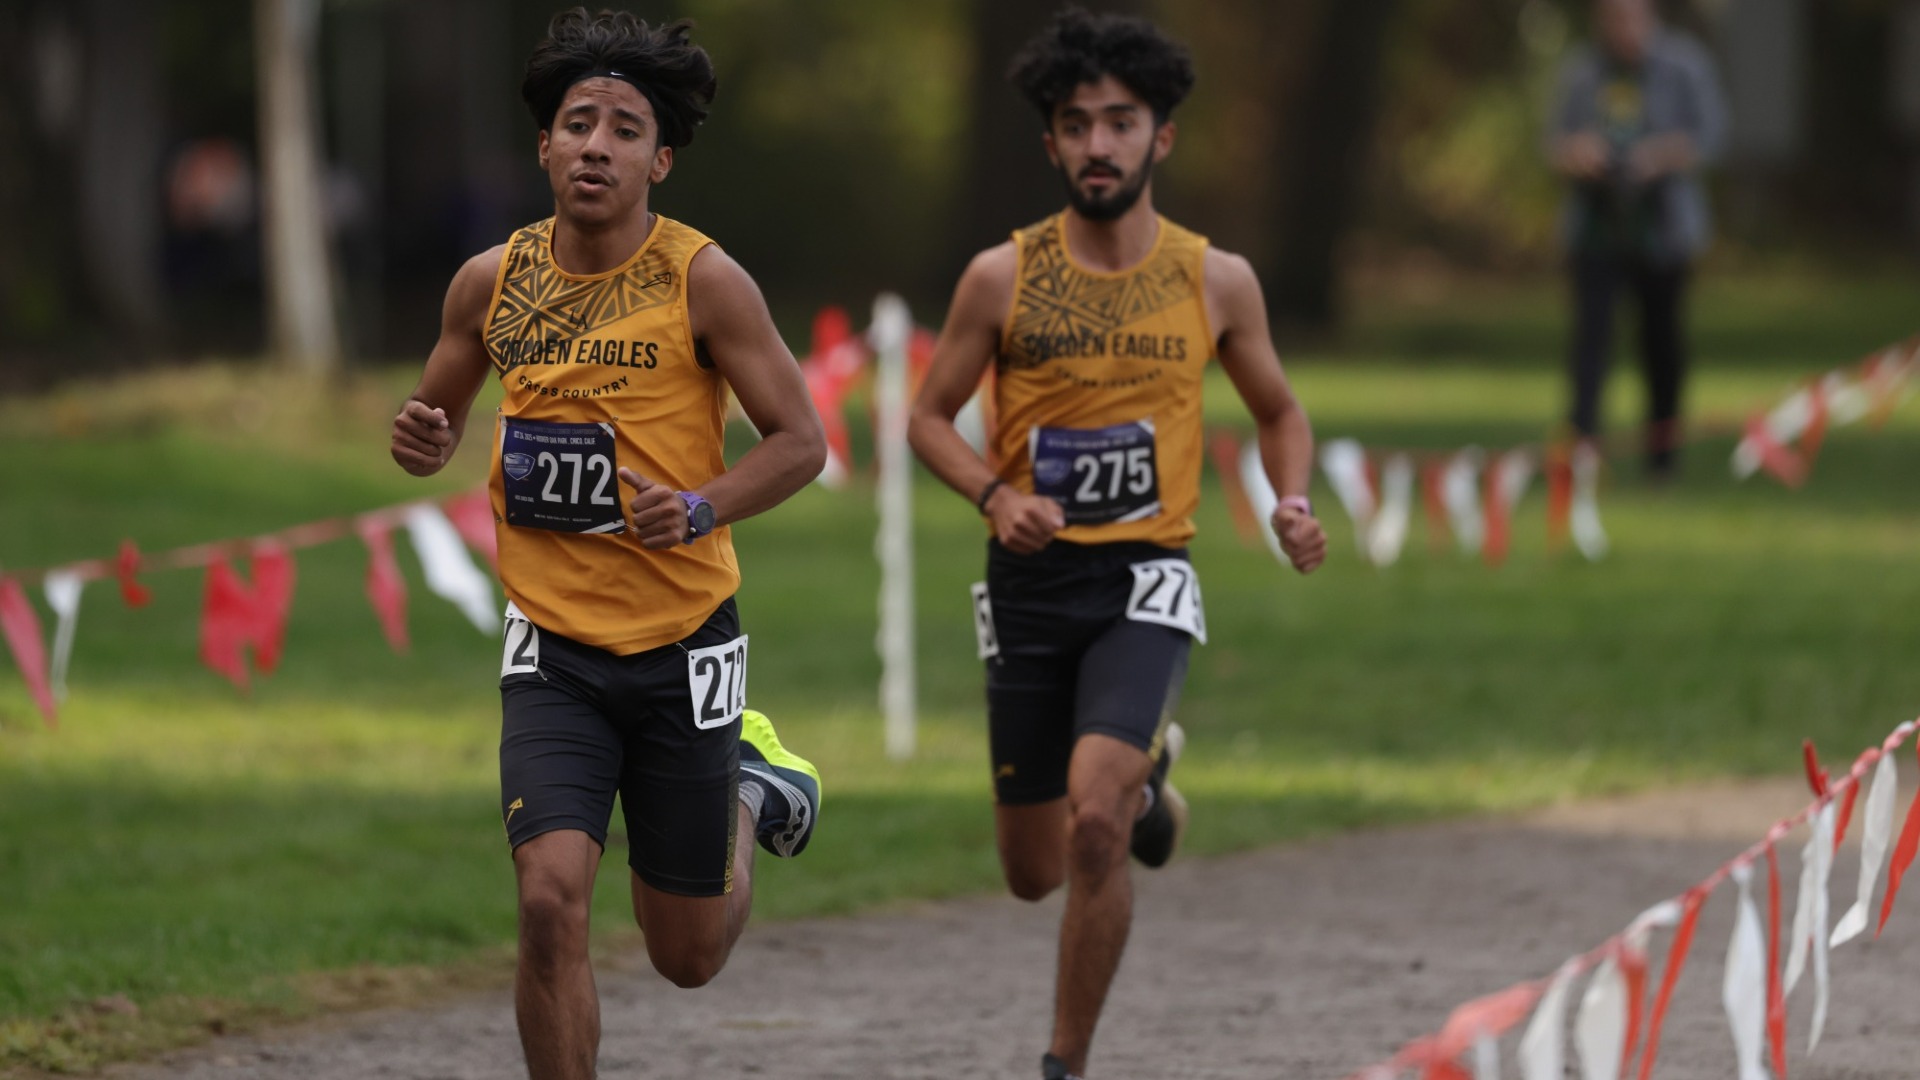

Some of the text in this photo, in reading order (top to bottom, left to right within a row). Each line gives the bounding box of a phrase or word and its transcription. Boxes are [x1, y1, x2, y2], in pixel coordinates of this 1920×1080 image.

[500, 339, 659, 369] GOLDEN EAGLES
[1112, 332, 1187, 362] EAGLES
[518, 375, 629, 399] CROSS COUNTRY
[538, 451, 615, 505] 272
[1073, 446, 1153, 502] 275
[695, 644, 745, 721] 272
